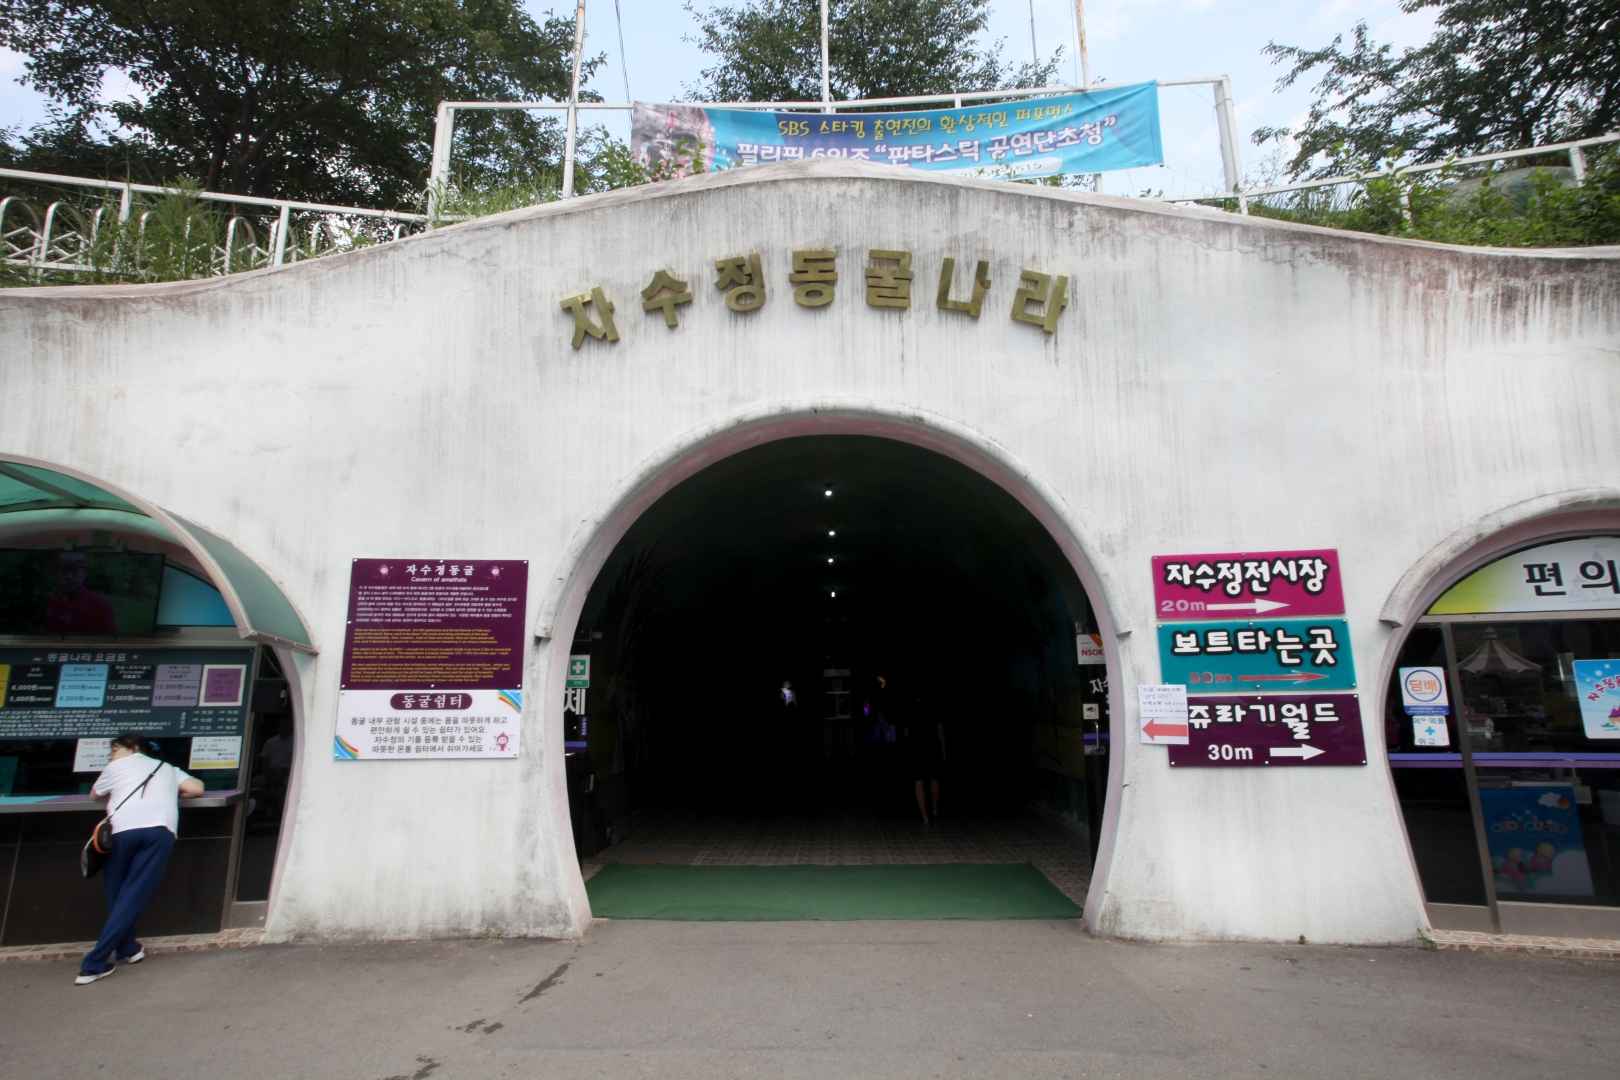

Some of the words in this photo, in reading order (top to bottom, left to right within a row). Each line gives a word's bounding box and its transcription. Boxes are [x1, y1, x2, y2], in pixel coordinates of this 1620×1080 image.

[737, 143, 803, 166] 필리핀
[987, 113, 1118, 160] 공연단초청”
[778, 121, 809, 136] SBS
[874, 117, 931, 140] 출연진의
[940, 110, 1008, 133] 환상적인
[560, 249, 1069, 350] 자수정동굴나라
[405, 564, 475, 576] 자수정동굴
[1166, 558, 1329, 596] 자수정전시장
[1523, 559, 1620, 596] 편의
[1161, 600, 1206, 612] 20m
[1173, 628, 1338, 665] 보트타는곳
[402, 694, 462, 708] 동굴쉼터
[1409, 679, 1437, 692] 담배
[1188, 703, 1340, 740] 쥬라기월드
[1207, 744, 1254, 761] 30m
